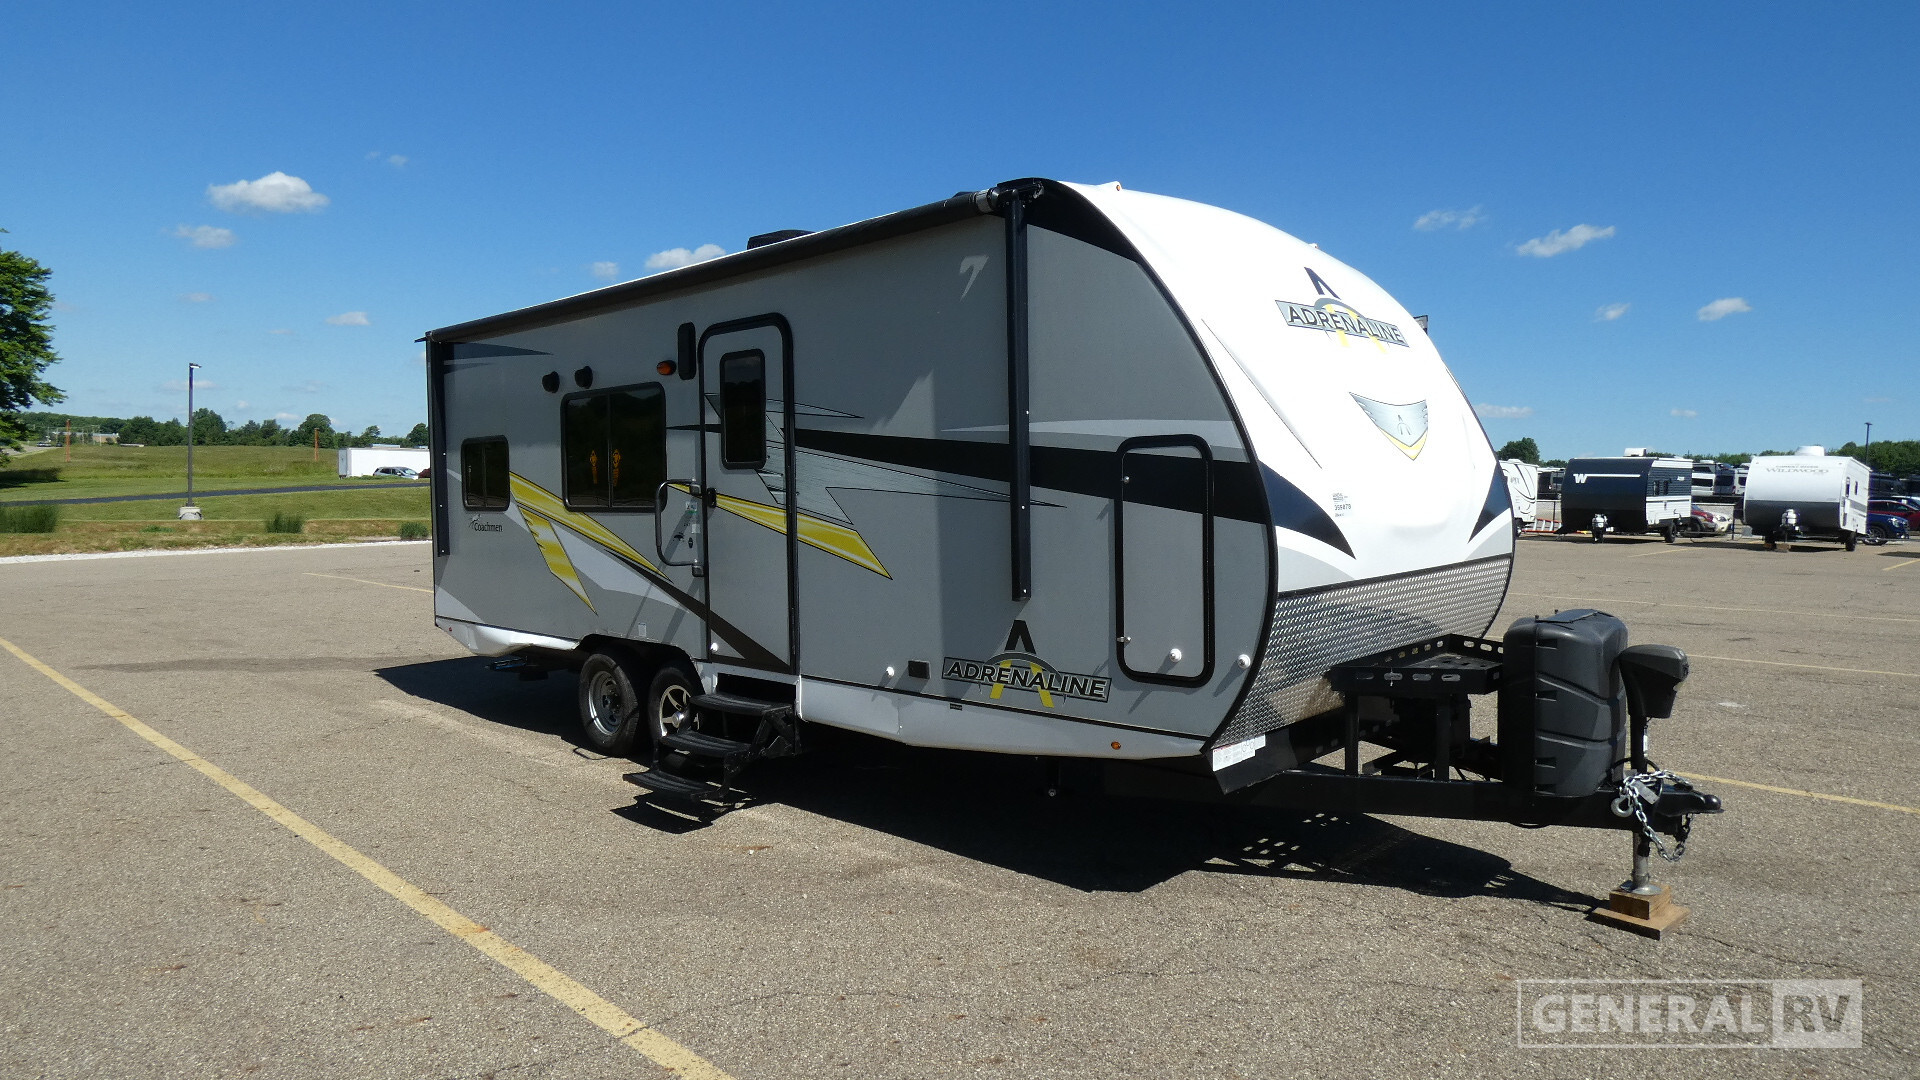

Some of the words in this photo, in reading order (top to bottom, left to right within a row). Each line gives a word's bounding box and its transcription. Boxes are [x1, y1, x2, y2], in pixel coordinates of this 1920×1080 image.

[1288, 305, 1405, 344] ADRENALINE
[474, 521, 504, 532] Coachmen
[944, 661, 1108, 699] ADRENALINE
